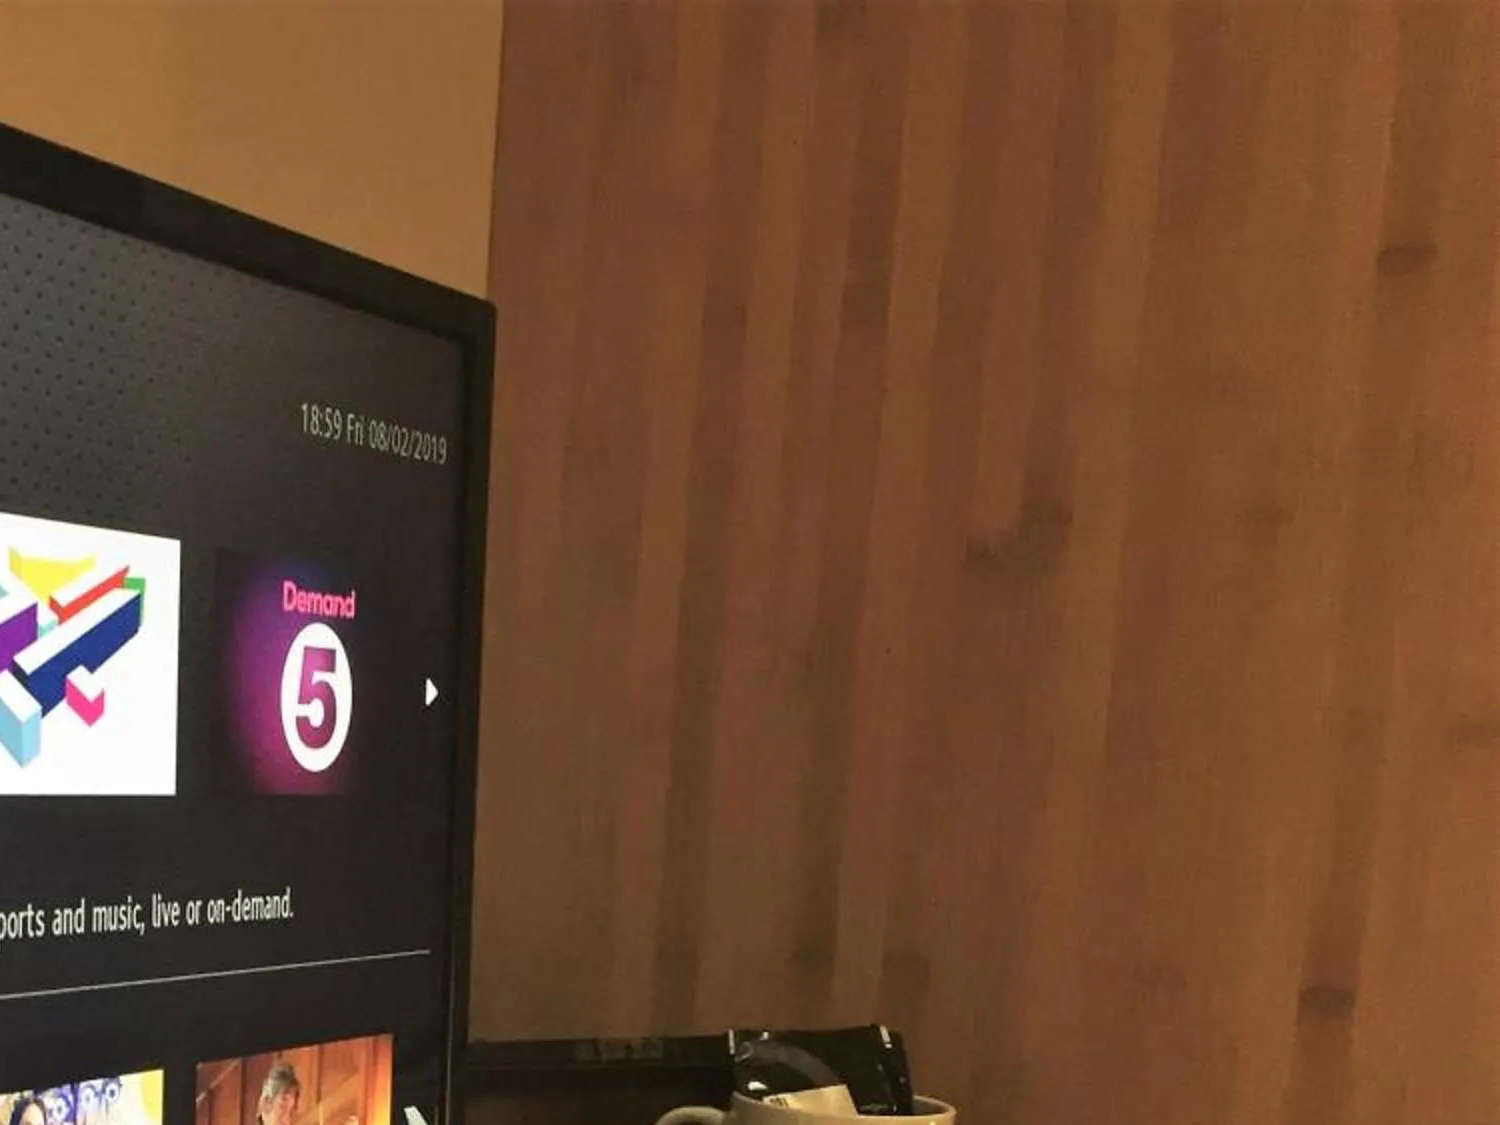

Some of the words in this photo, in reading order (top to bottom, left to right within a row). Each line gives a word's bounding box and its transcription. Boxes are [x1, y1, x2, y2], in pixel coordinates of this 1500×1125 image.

[301, 402, 343, 441] 18:59
[346, 412, 364, 447] Fri
[368, 419, 448, 465] 08/02/2019
[282, 579, 357, 620] Demand
[295, 645, 338, 750] 5
[51, 897, 86, 937] and
[91, 895, 146, 936] music,
[151, 892, 181, 929] live
[185, 898, 203, 926] or
[206, 885, 295, 925] on-demand.
